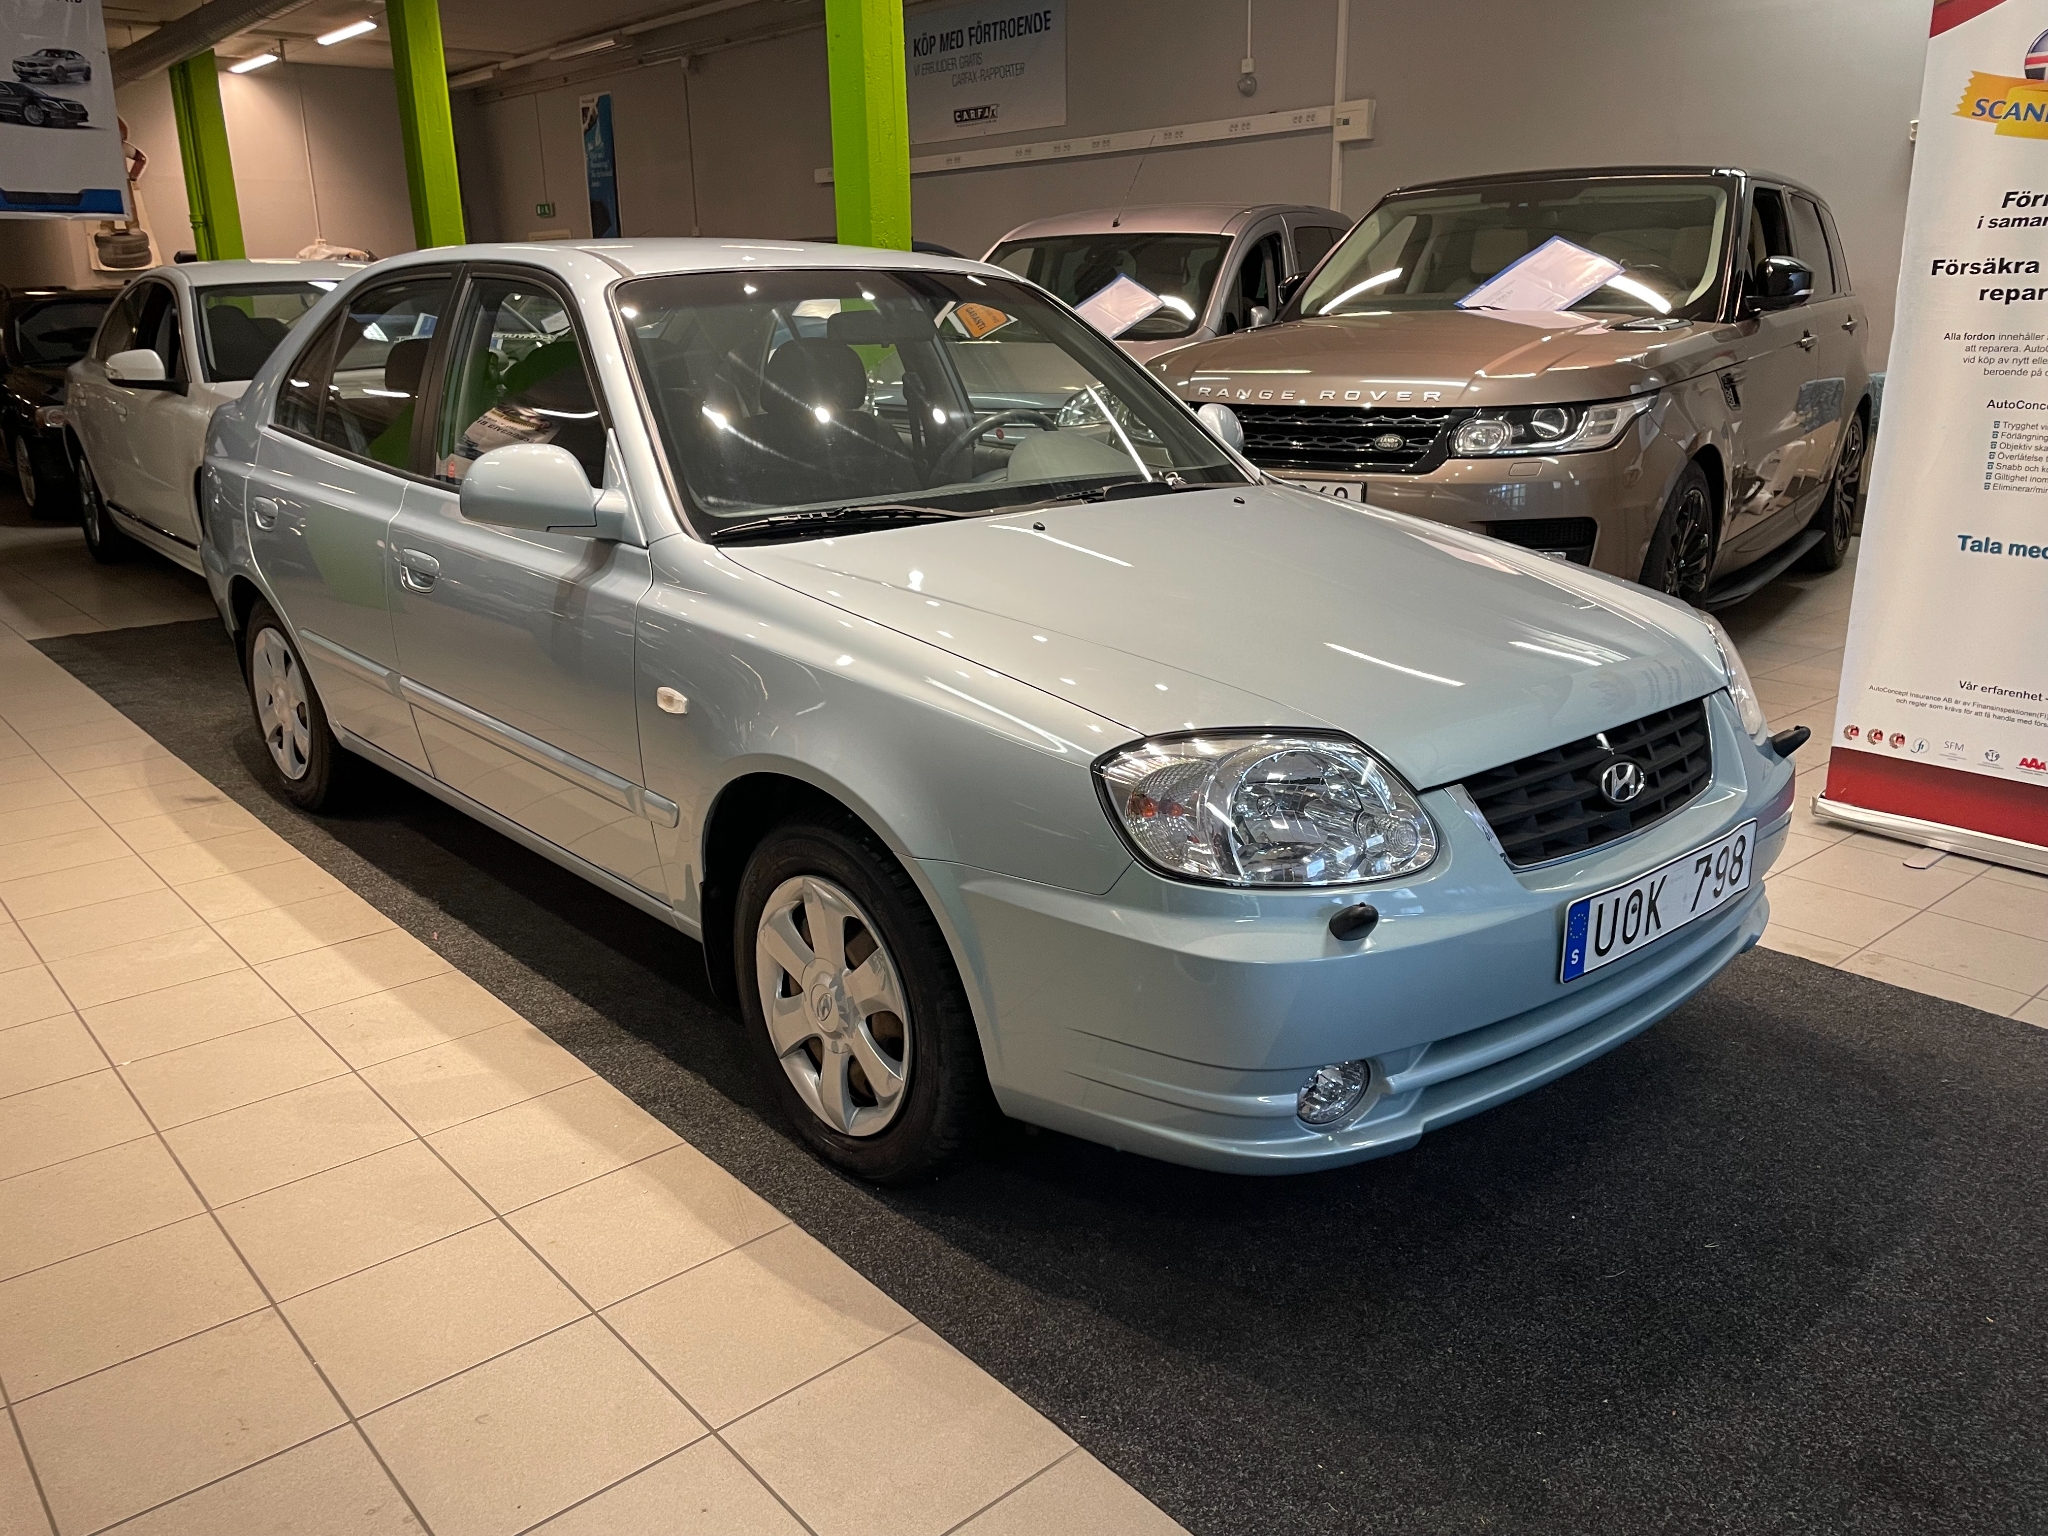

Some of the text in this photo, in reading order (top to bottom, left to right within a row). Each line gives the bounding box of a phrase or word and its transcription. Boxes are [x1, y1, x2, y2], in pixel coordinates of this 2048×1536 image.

[913, 10, 1052, 57] KÖP MED FÖRTROENDE
[959, 53, 983, 69] GRATIS
[952, 62, 1026, 87] CARFAX-RAPPORTER
[954, 105, 998, 122] CARFAX
[1971, 98, 2048, 122] SCAN
[1977, 215, 1985, 229] i
[1931, 258, 2040, 275] Försäkra
[965, 307, 987, 331] GARANTI
[1943, 331, 2046, 341] Alla fordon innehåller
[1964, 345, 1977, 353] att
[1978, 345, 2022, 354] reparera.
[1963, 356, 1976, 364] vid
[1978, 356, 1996, 366] köp
[2012, 357, 2030, 366] nytt
[1983, 367, 2043, 378] beroende på
[1197, 387, 1443, 402] RANGE ROVER
[1986, 399, 2048, 410] AutoConc
[2002, 421, 2039, 431] Trygghet
[1999, 442, 2033, 451] Objektiv
[1997, 451, 2044, 462] Överlåtelse
[1995, 462, 2023, 471] Snabb
[1994, 472, 2028, 483] Giltighet
[1957, 534, 2003, 555] Tala
[1868, 684, 1909, 697] AutoConcept
[1942, 696, 1953, 704] AB
[1959, 680, 2043, 702] Vår erfarenhet
[1908, 700, 1928, 708] regler
[1944, 705, 1963, 713] krävs
[1992, 713, 2016, 723] handla
[1944, 741, 1965, 752] SFM
[2018, 757, 2047, 771] AAA
[1594, 834, 1747, 957] UOK 798
[1571, 948, 1580, 965] S
